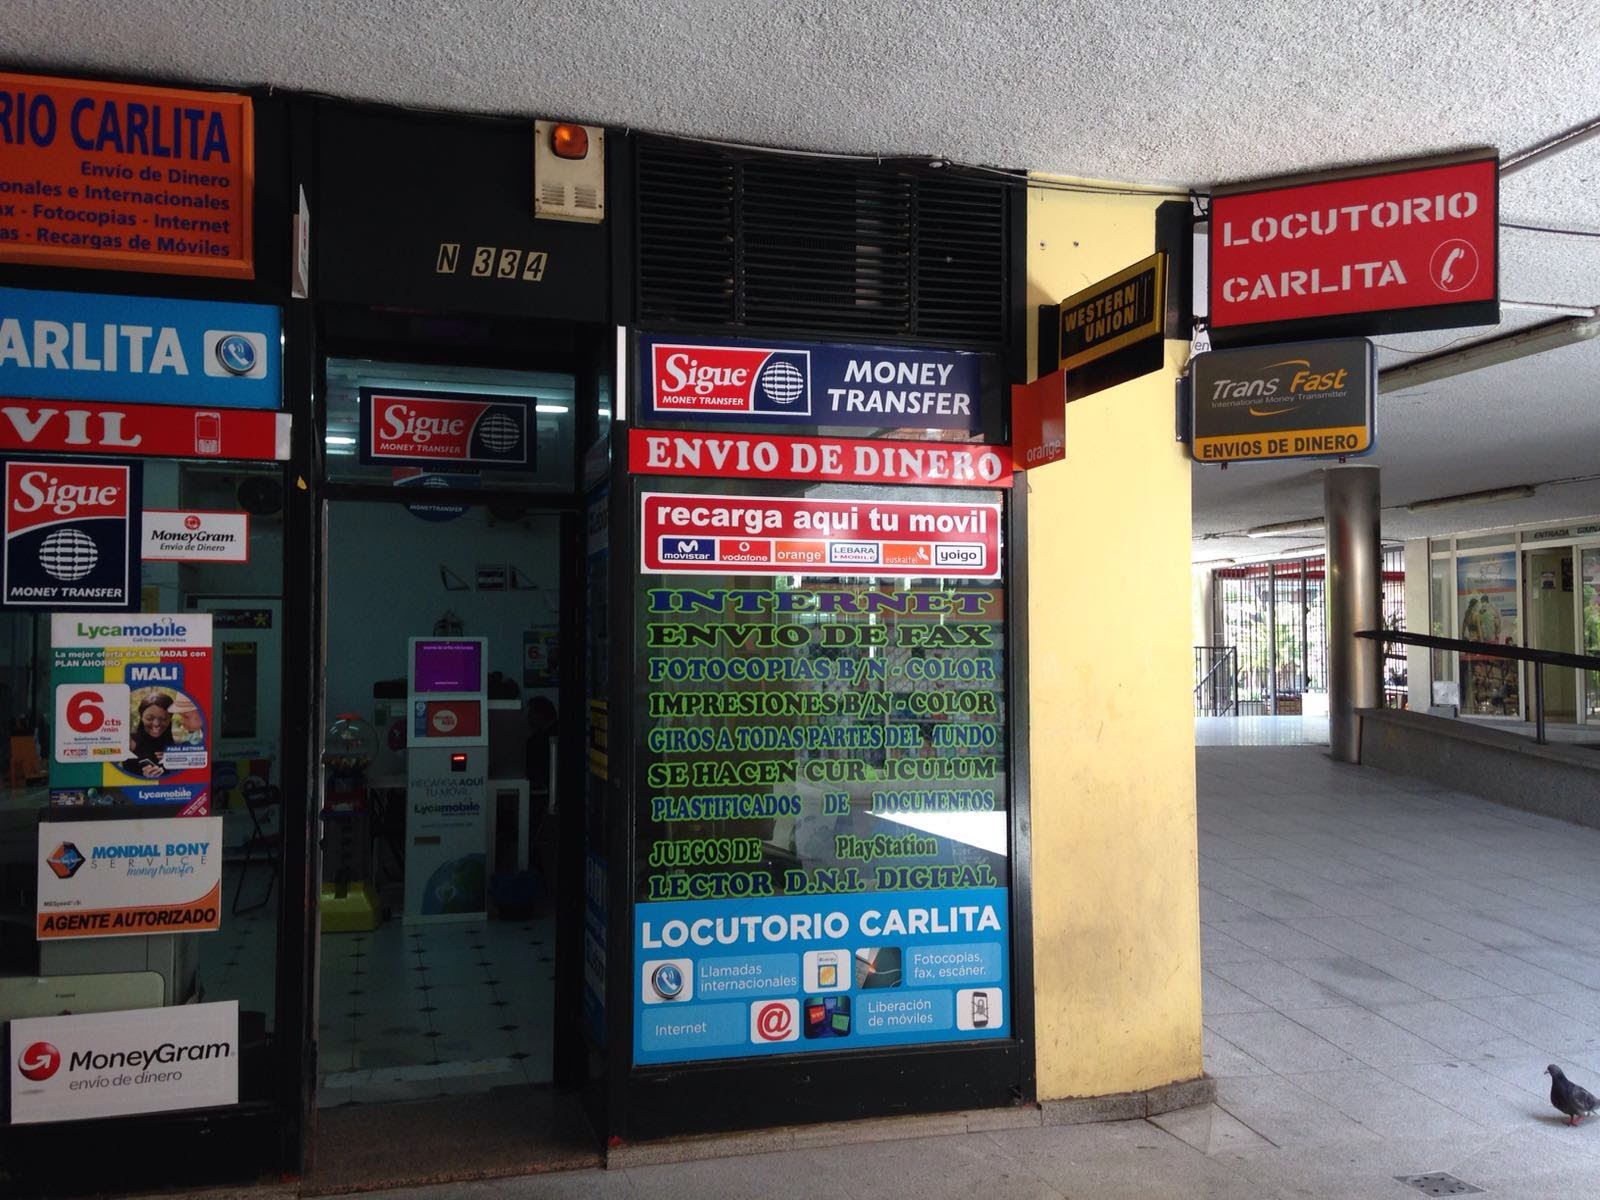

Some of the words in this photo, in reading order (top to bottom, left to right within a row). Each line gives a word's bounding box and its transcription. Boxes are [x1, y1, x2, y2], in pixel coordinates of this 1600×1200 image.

[71, 97, 230, 163] CARLITA
[140, 166, 162, 181] de
[168, 168, 230, 188] Dinero
[68, 187, 78, 198] e
[85, 185, 230, 211] Internacionales
[33, 204, 136, 227] Fotocopias
[154, 213, 230, 234] Internet
[1223, 191, 1478, 247] LOCUTORIO
[37, 227, 122, 249] Recargas
[129, 234, 151, 250] de
[157, 236, 230, 256] Móviles
[437, 245, 458, 272] N
[474, 248, 545, 280] 334
[1223, 259, 1408, 302] CARLITA
[1064, 281, 1137, 332] WESTERN
[1085, 304, 1136, 343] UNION
[661, 353, 748, 395] Sigue
[844, 360, 954, 386] MONEY
[1213, 377, 1280, 400] Trans
[1290, 368, 1347, 393] Fast
[662, 396, 697, 404] MONEY
[699, 397, 744, 405] TRANSFER
[828, 388, 971, 416] TRANSFER
[1212, 397, 1263, 408] International
[1265, 396, 1294, 404] Money
[1298, 391, 1347, 400] Transmitter
[1, 407, 142, 447] VIL
[379, 404, 465, 443] Sigue
[380, 442, 414, 452] MONEY
[417, 444, 461, 454] TRANSFER
[1027, 438, 1062, 462] orange
[1203, 440, 1261, 458] ENVIOS
[1268, 438, 1288, 454] DE
[1295, 434, 1358, 452] DINERO
[646, 436, 779, 473] ENVIO
[790, 443, 843, 475] DE
[854, 446, 1002, 482] DINERO
[14, 471, 118, 515] Sigue
[658, 505, 782, 534] recarga
[793, 506, 858, 536] aqui
[869, 508, 899, 531] tu
[909, 509, 987, 534] movil
[151, 530, 234, 543] MoneyGram
[1535, 528, 1569, 538] ENTRADA
[185, 543, 195, 551] de
[197, 544, 225, 552] Dinero
[722, 554, 768, 562] vodafone
[777, 551, 821, 562] orange
[941, 550, 977, 562] yoigo
[11, 586, 58, 597] MONEY
[61, 587, 122, 597] TRANSFER
[648, 589, 994, 614] INTERNET
[77, 622, 187, 639] Lycamobile
[648, 624, 811, 648] ENVIO
[822, 625, 889, 648] DE
[896, 625, 993, 648] FAX
[55, 650, 66, 658] La
[69, 651, 93, 660] mejor
[140, 650, 188, 658] LLAMADAS
[131, 667, 178, 681] MALI
[649, 656, 831, 682] FOTOCOPIAS
[836, 657, 888, 686] B/N
[905, 657, 996, 680] COLOR
[67, 691, 104, 733] 6
[649, 691, 838, 717] IMPRESIONES
[843, 691, 893, 720] B/N
[908, 690, 996, 715] COLOR
[104, 718, 122, 726] cts
[648, 727, 714, 752] GIROS
[716, 726, 734, 751] A
[735, 726, 805, 750] TODAS
[807, 725, 884, 749] PARTES
[884, 724, 923, 748] DEL
[648, 762, 689, 787] SE
[693, 760, 800, 787] HACEN
[804, 757, 996, 783] CURICULUM
[139, 788, 192, 800] Lycamobile
[651, 794, 802, 822] PLASTIFICADOS
[823, 791, 850, 816] DE
[872, 789, 995, 814] DOCUMENTOS
[414, 802, 480, 814] Lycamobile
[92, 846, 160, 858] MONDIAL
[166, 843, 210, 856] BONY
[650, 839, 731, 866] JUEGOS
[732, 838, 762, 862] DE
[835, 833, 938, 862] PlayStation
[91, 856, 206, 869] SERVICE
[127, 866, 158, 877] money
[159, 864, 194, 877] transfer
[649, 871, 773, 900] LECTOR
[784, 867, 866, 894] D.N.I.
[876, 864, 997, 890] DIGITAL
[43, 914, 110, 931] AGENTE
[113, 909, 216, 928] AUTORIZADO
[641, 911, 849, 949] LOCUTORIO
[859, 905, 1001, 937] CARLITA
[701, 963, 762, 978] Llamadas
[914, 951, 983, 966] Fotocopias,
[701, 976, 797, 992] internacionales
[914, 968, 936, 979] fax,
[868, 999, 931, 1013] Liberación
[654, 1021, 707, 1037] Internet
[868, 1014, 883, 1027] de
[887, 1013, 933, 1026] móviles
[69, 1041, 230, 1071] MoneyGram
[113, 1072, 132, 1087] de
[135, 1069, 182, 1085] dinero
